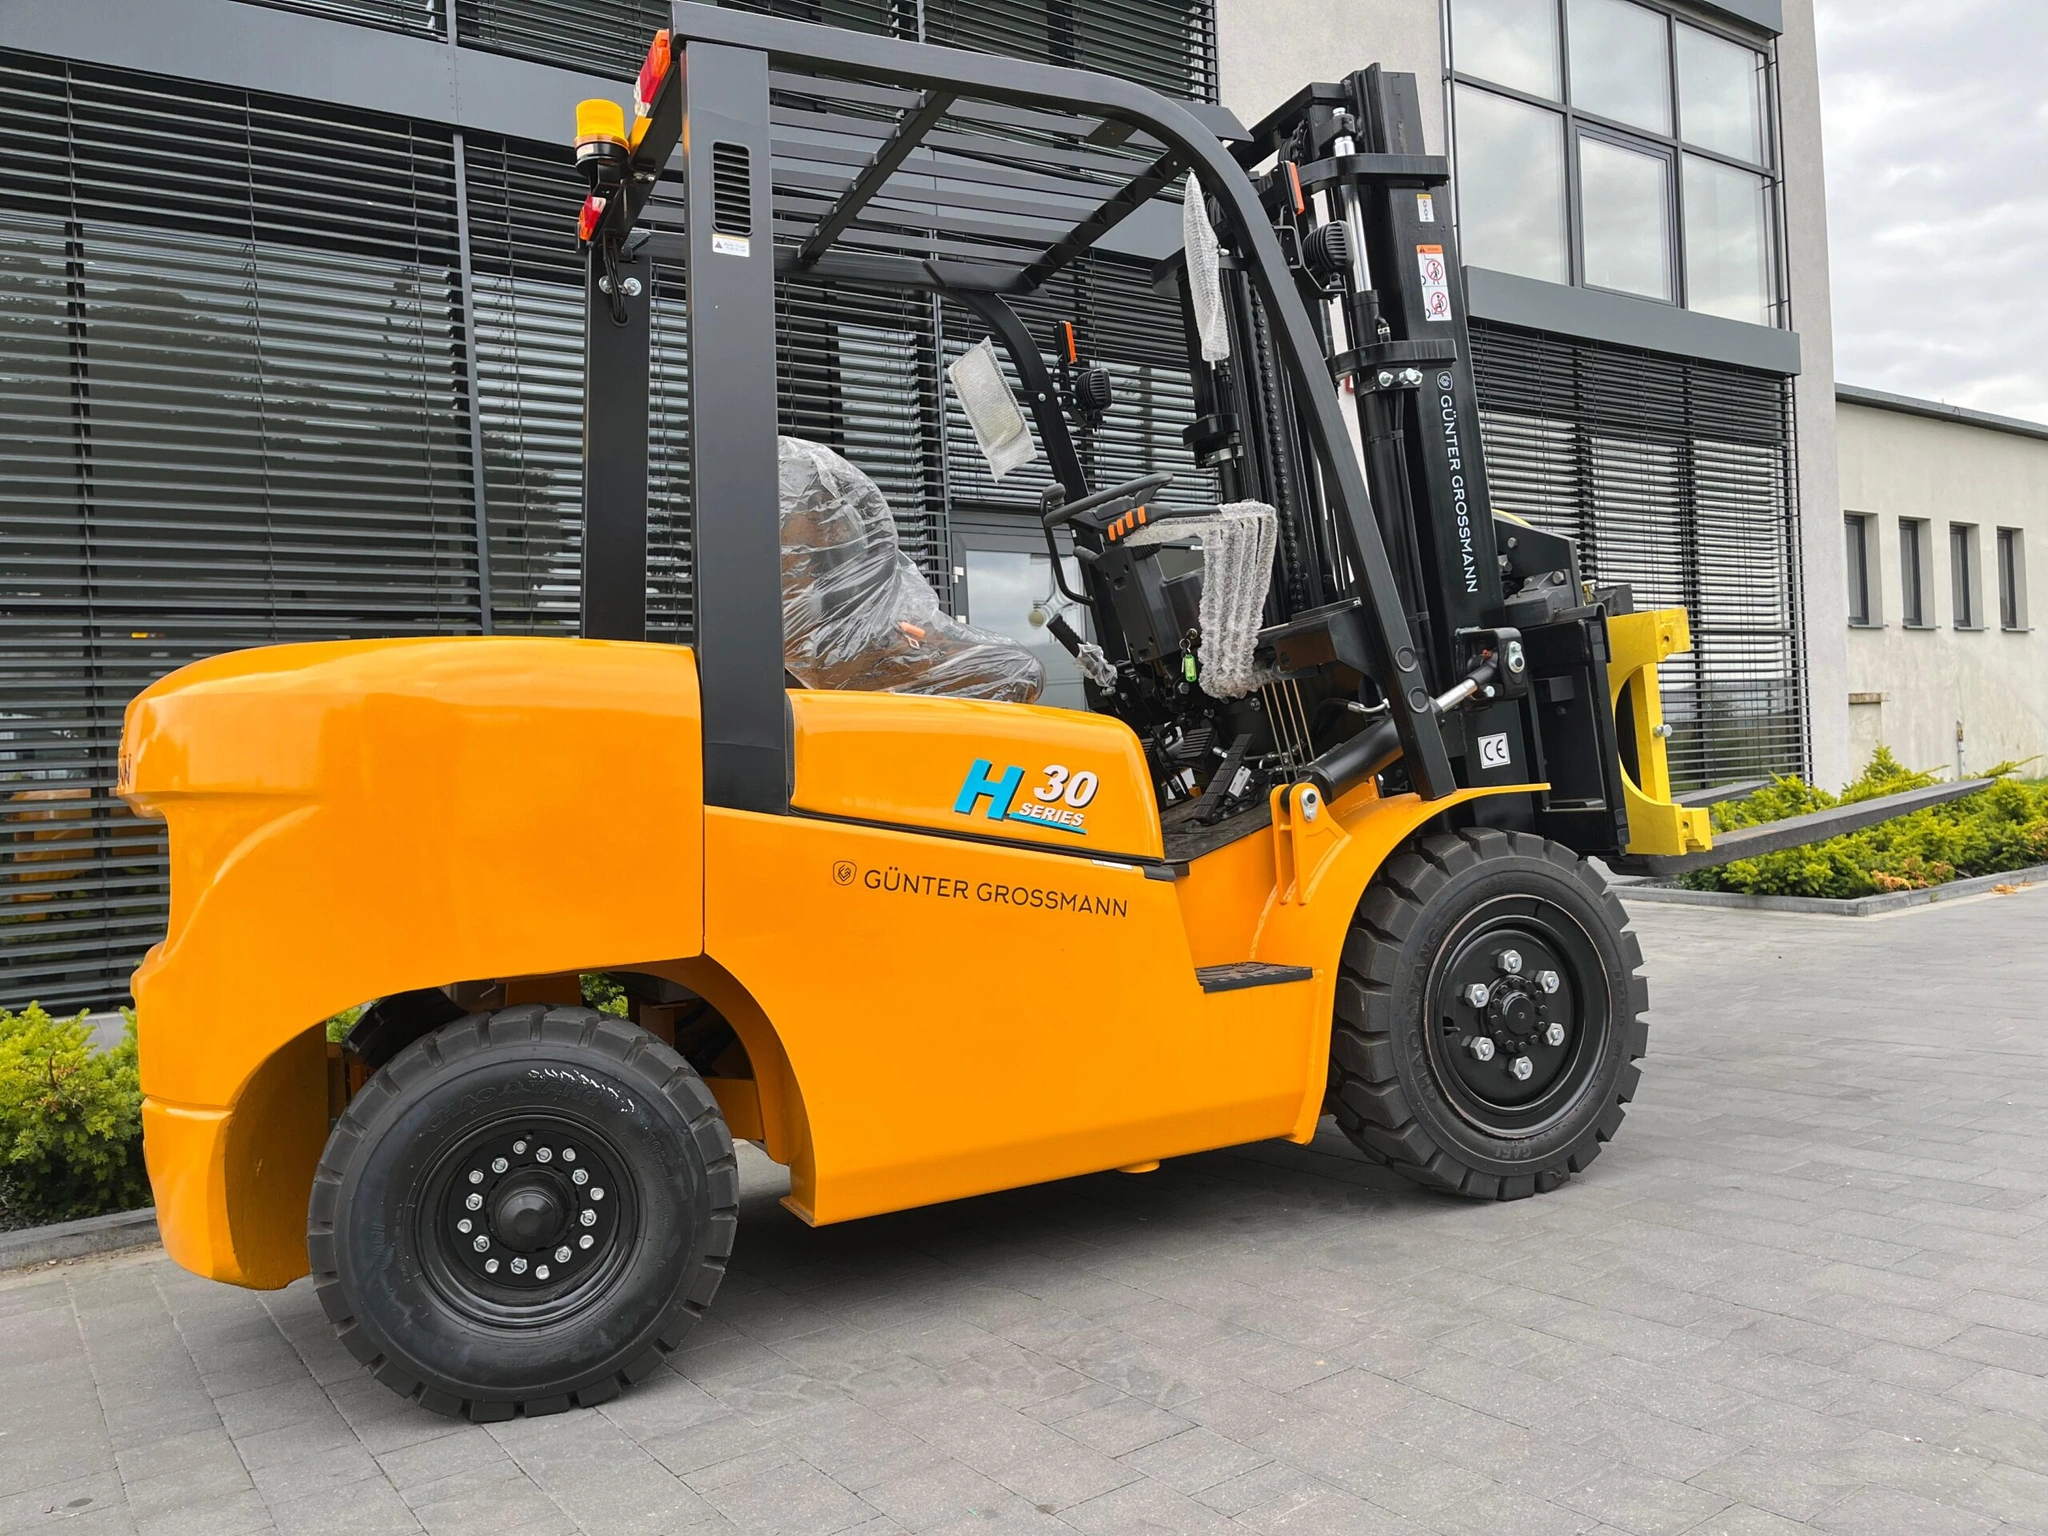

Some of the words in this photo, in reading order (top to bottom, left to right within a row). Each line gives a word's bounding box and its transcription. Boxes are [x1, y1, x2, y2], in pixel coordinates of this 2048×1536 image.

[1440, 394, 1461, 471] GÜNTER
[1452, 475, 1478, 593] GROSSMANN
[1484, 738, 1506, 761] CE
[953, 758, 1024, 822] H
[1033, 764, 1099, 809] 30
[1018, 802, 1084, 827] SERIES
[864, 866, 970, 900] GÜNTER
[976, 882, 1128, 918] GROSSMANN
